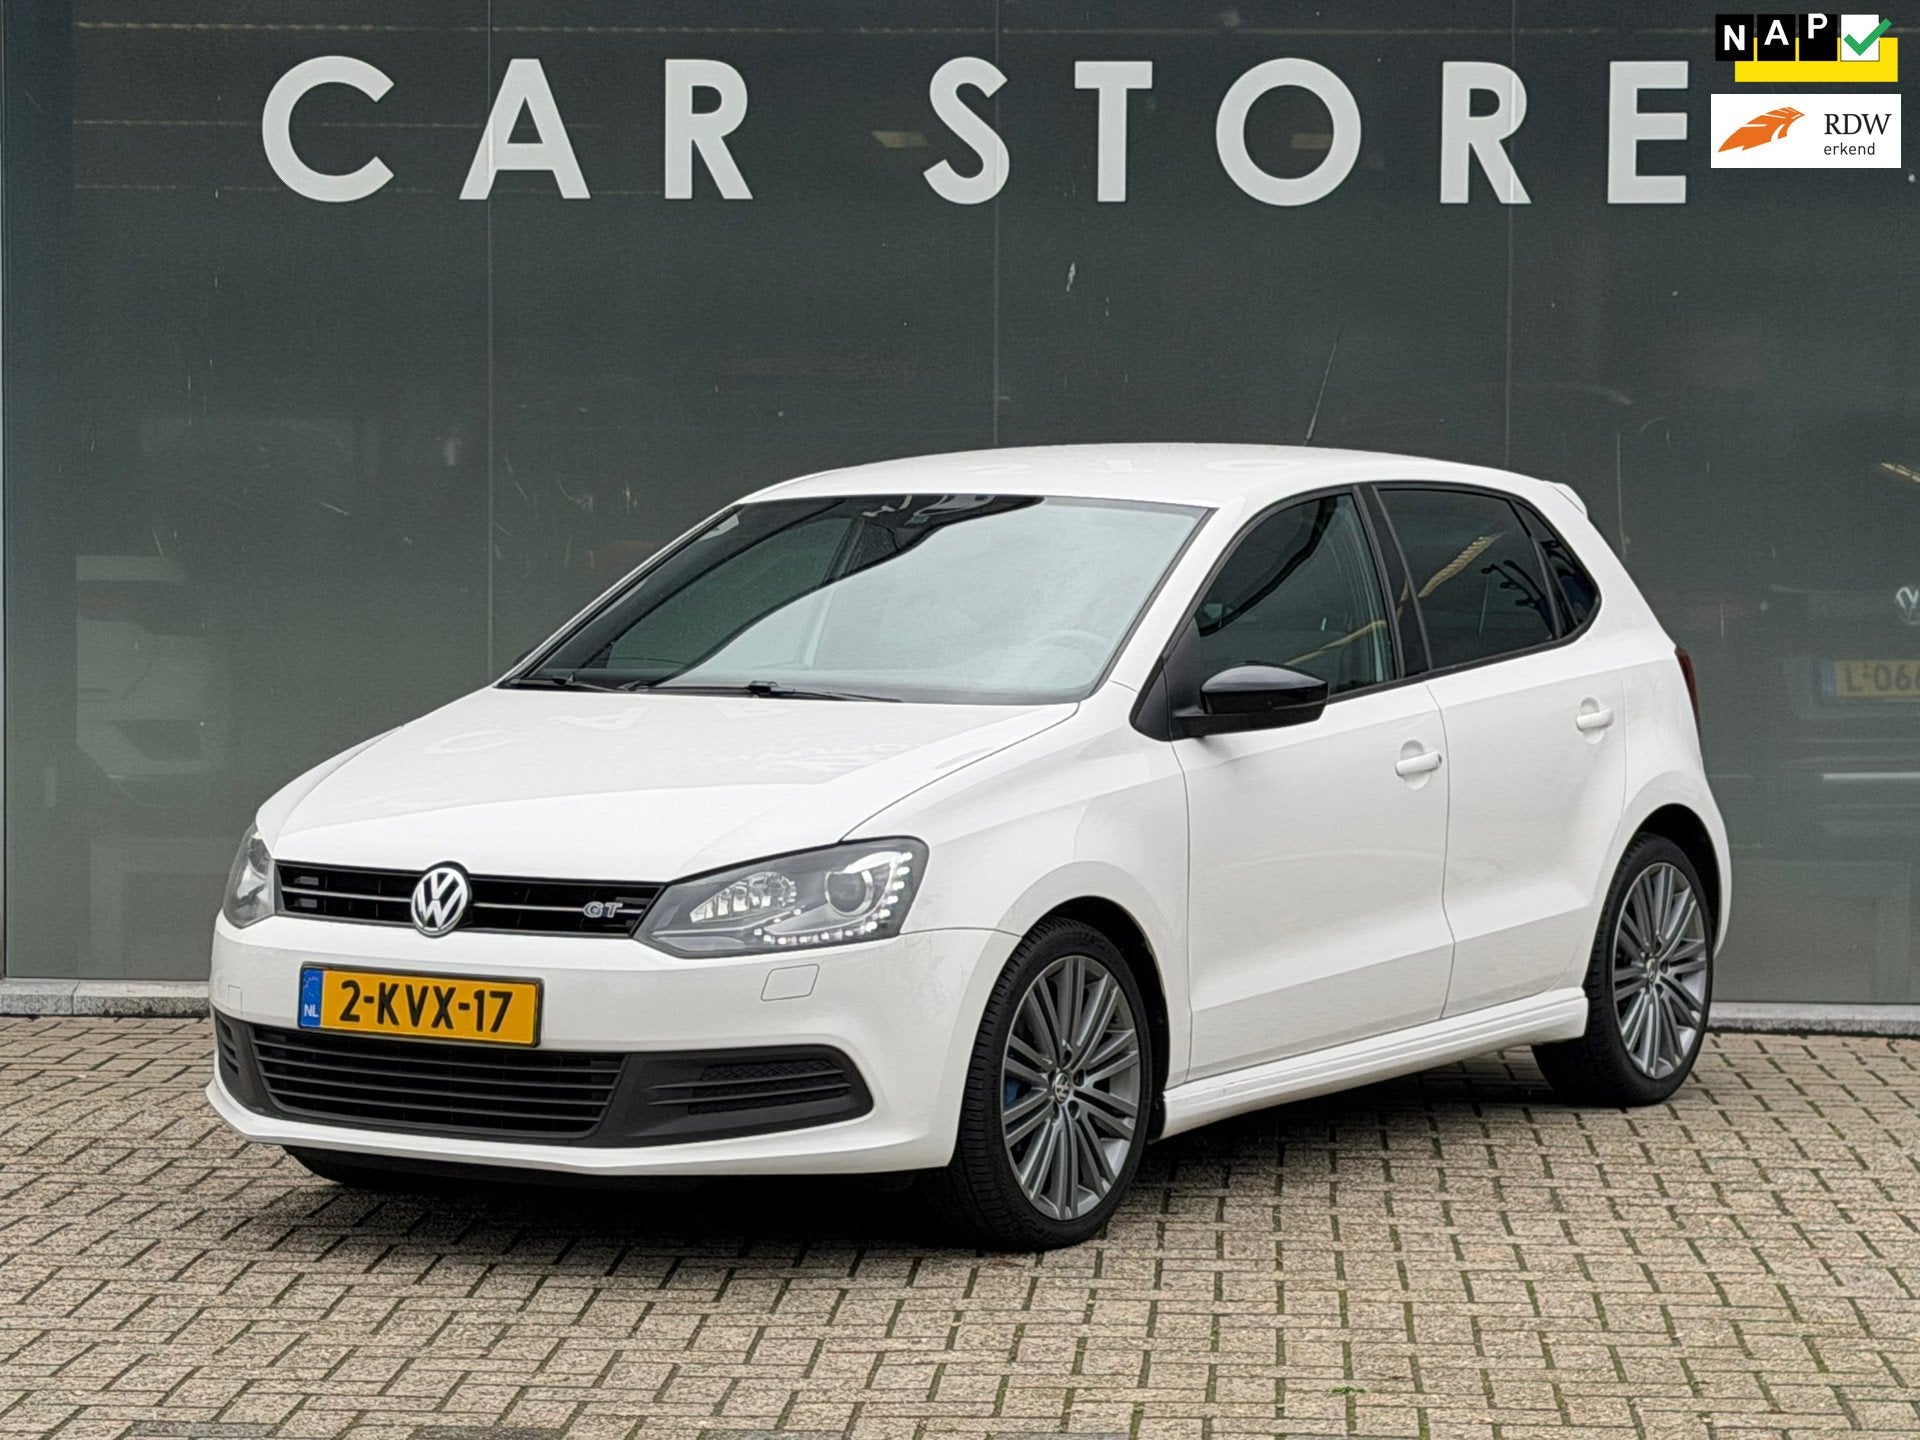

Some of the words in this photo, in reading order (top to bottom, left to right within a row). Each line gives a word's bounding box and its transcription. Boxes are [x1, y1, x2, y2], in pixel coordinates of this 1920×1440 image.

[262, 55, 753, 203] CAR
[923, 56, 1689, 207] STORE
[582, 901, 624, 919] GT
[303, 1003, 320, 1018] NL
[339, 979, 513, 1033] 2-KVX-17
